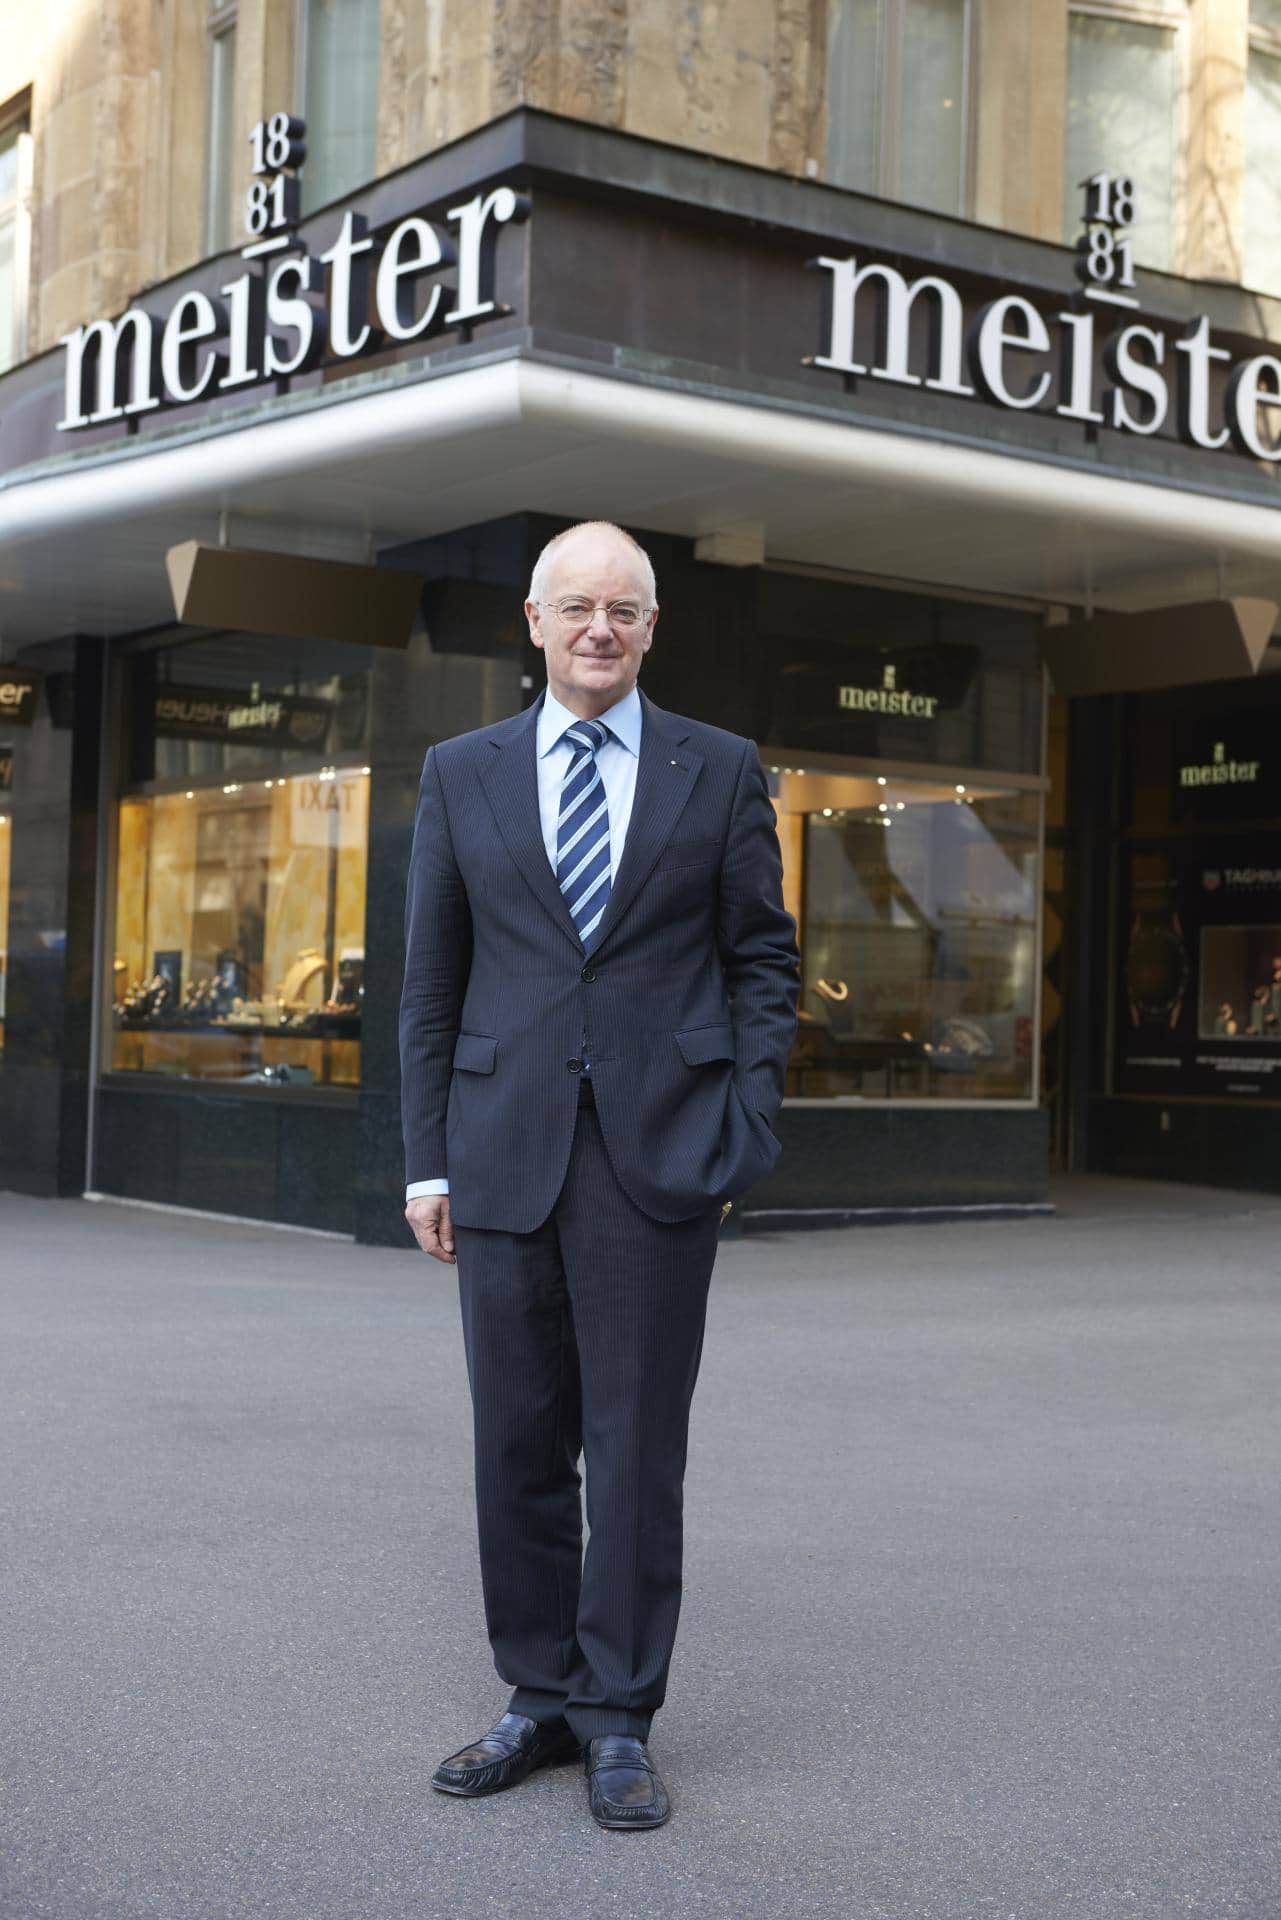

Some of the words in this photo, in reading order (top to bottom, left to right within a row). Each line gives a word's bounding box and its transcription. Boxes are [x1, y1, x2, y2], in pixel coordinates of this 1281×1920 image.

[249, 112, 291, 175] 18
[243, 176, 288, 236] 81
[1092, 170, 1137, 228] 18
[1087, 228, 1137, 288] 81
[56, 187, 516, 431] meister
[814, 256, 1281, 461] meiste
[838, 685, 939, 719] meister
[1180, 760, 1260, 787] meister
